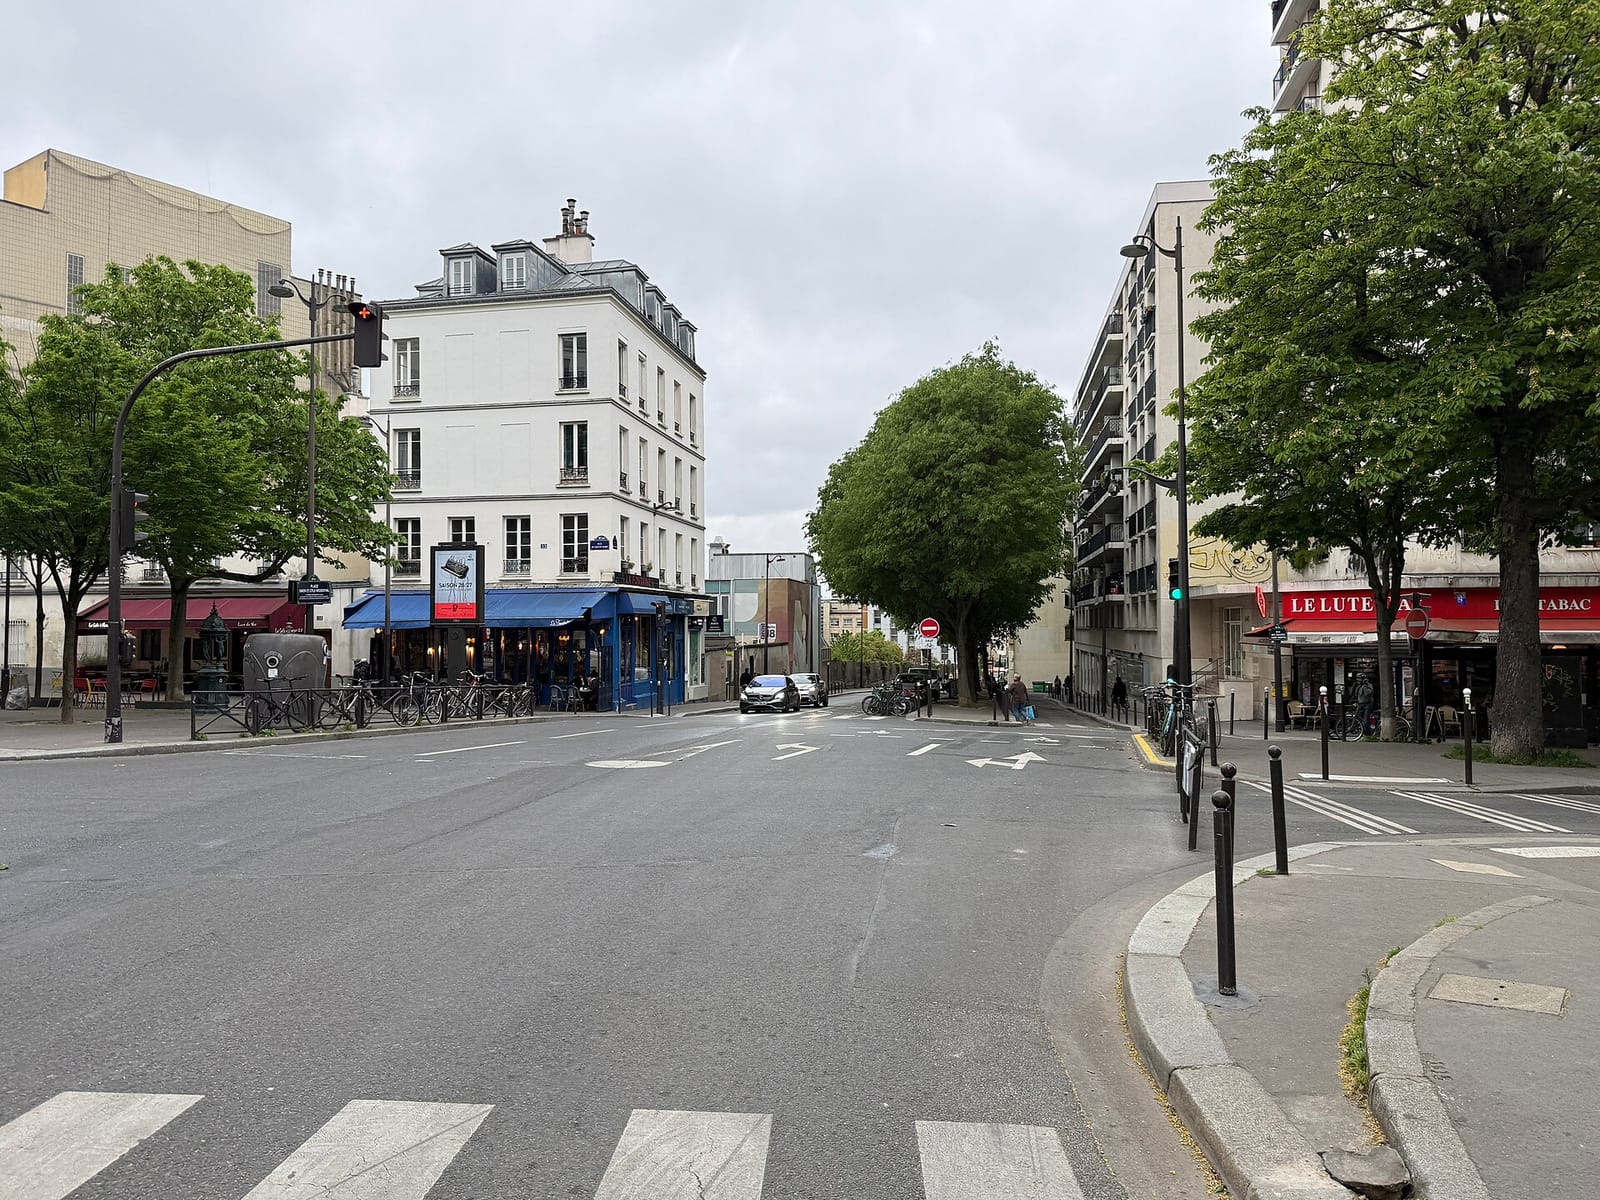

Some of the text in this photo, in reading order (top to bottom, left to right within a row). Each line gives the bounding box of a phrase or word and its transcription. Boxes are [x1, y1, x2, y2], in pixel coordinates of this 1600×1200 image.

[1291, 597, 1412, 613] LE LUTEA
[1538, 598, 1592, 611] TABAC
